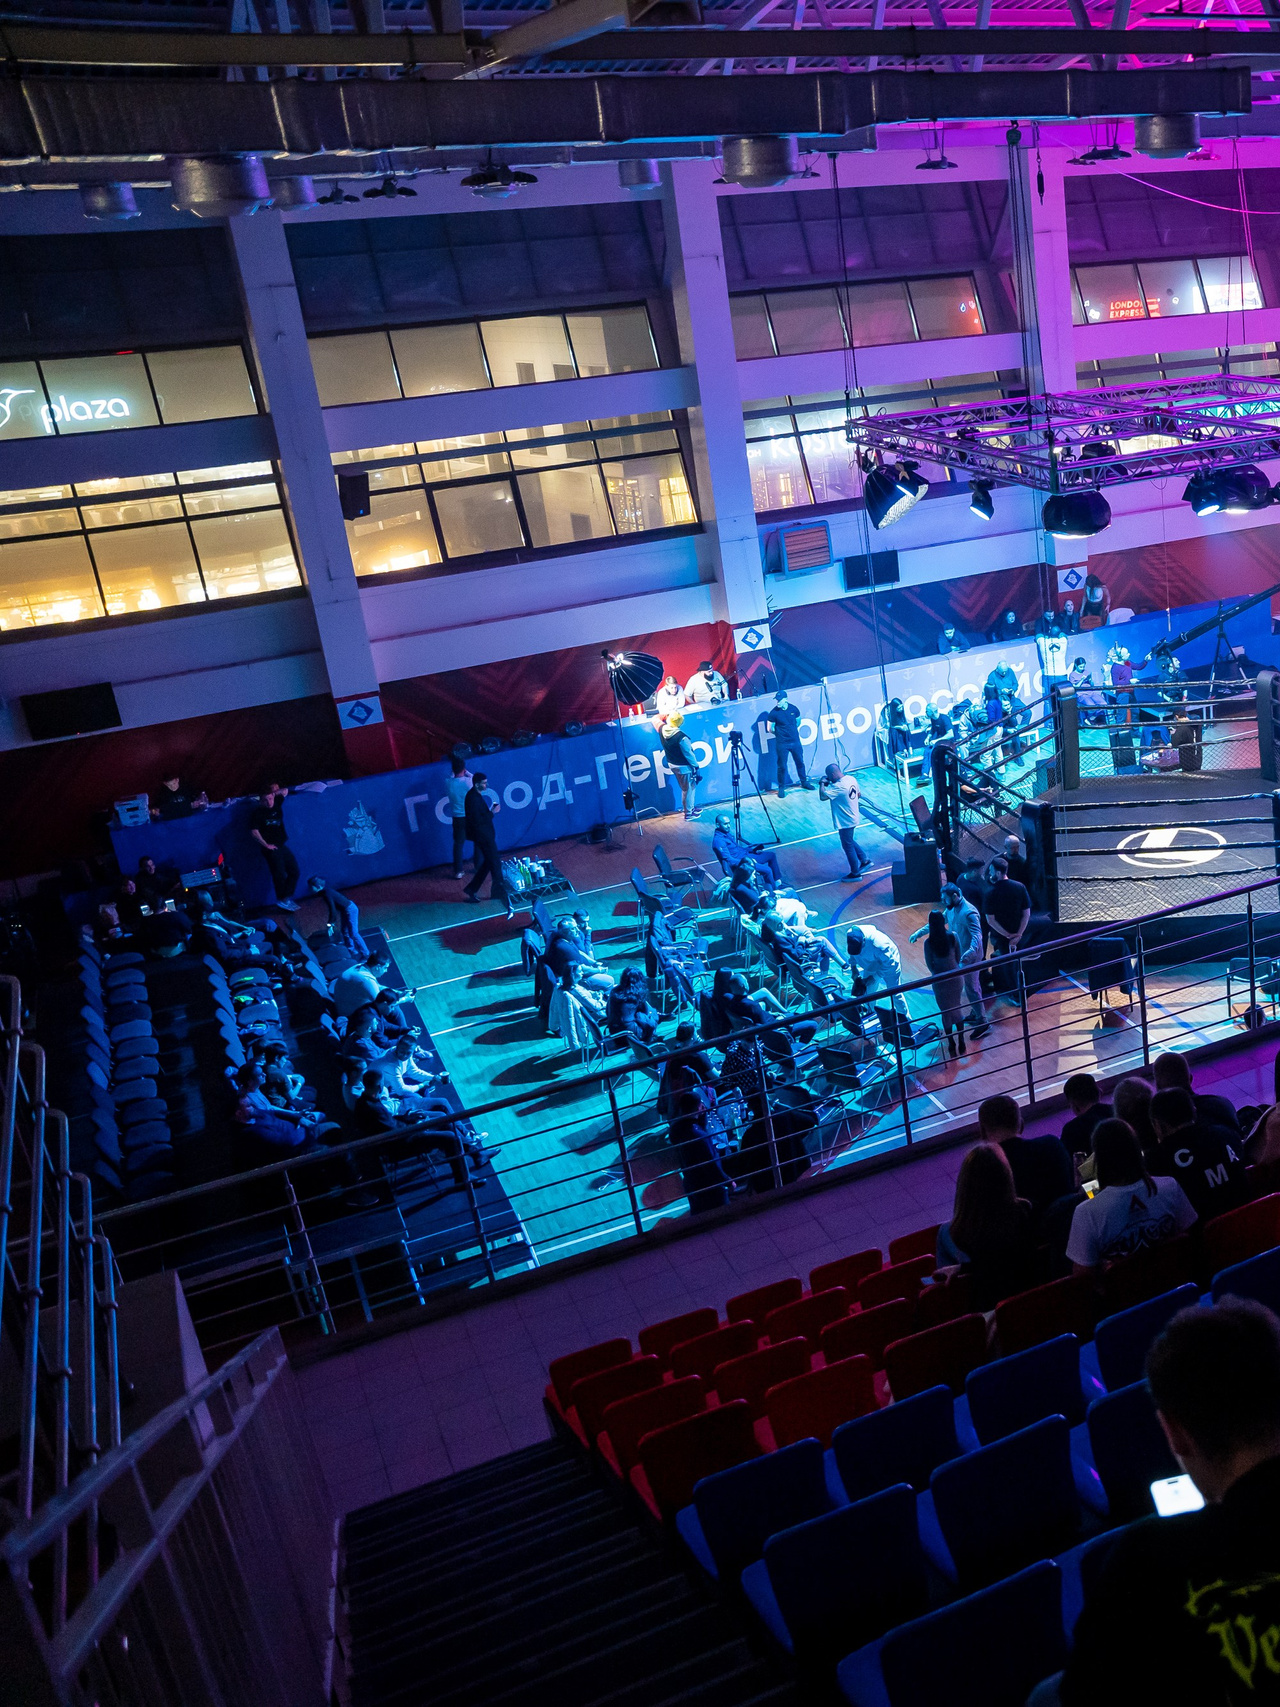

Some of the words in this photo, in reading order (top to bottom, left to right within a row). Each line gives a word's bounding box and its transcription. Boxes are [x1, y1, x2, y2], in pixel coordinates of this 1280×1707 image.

[1110, 299, 1144, 310] LONDO
[1109, 308, 1145, 318] EXPRESS
[41, 395, 130, 433] plaza
